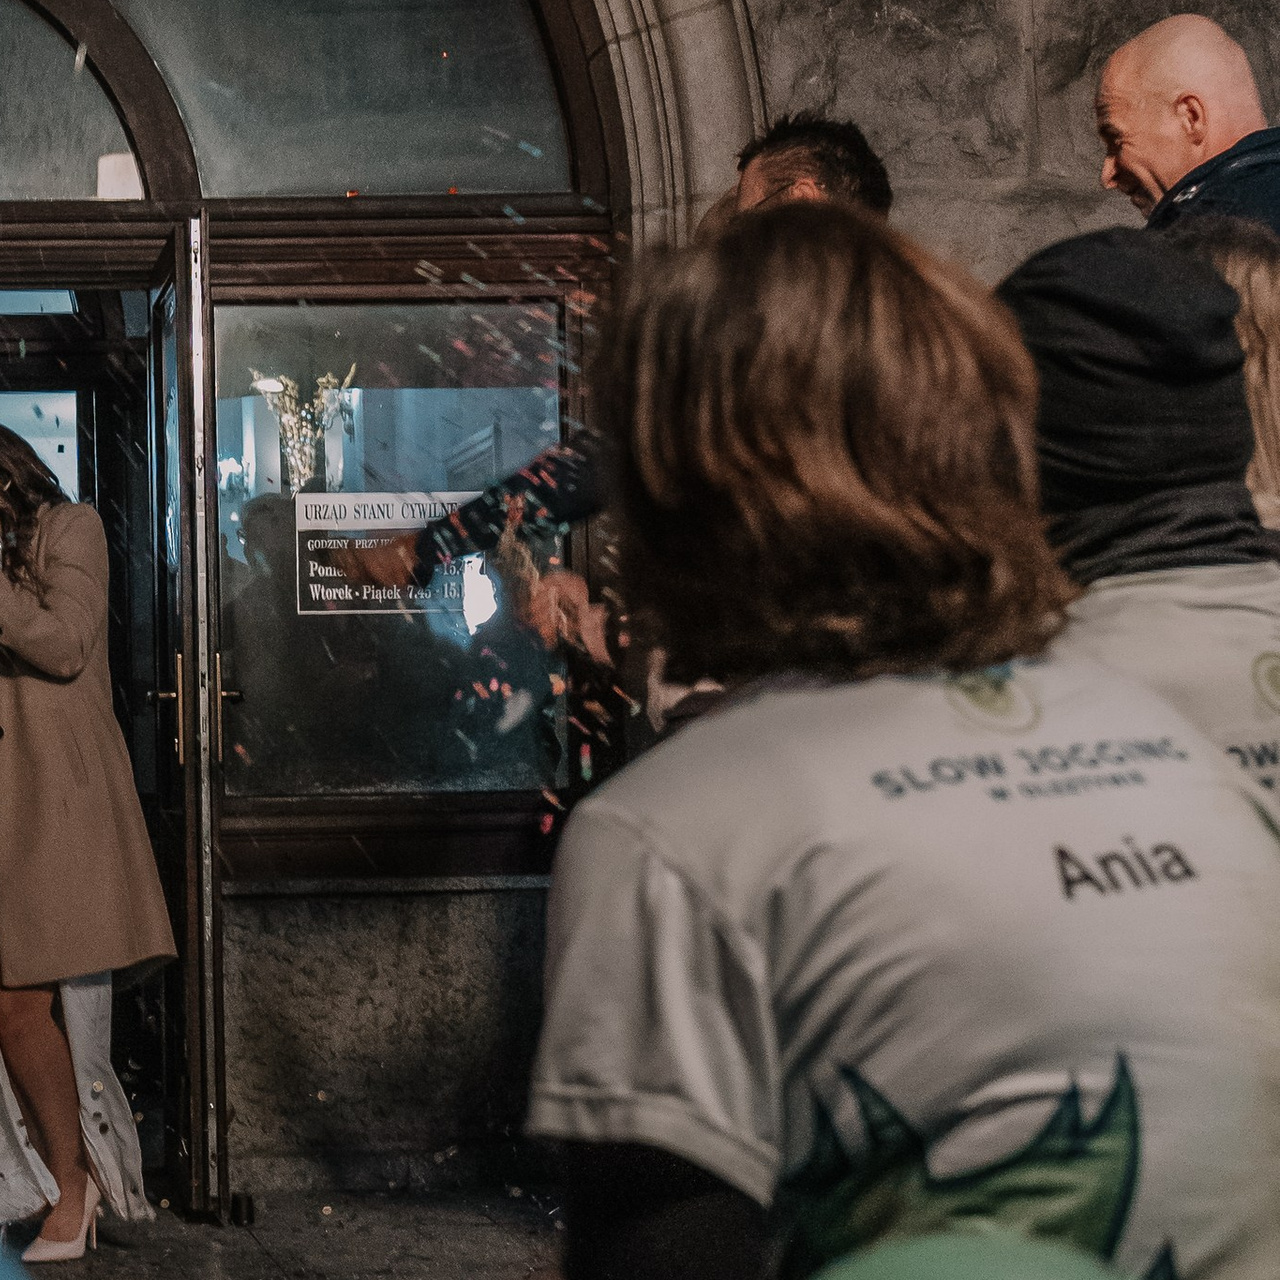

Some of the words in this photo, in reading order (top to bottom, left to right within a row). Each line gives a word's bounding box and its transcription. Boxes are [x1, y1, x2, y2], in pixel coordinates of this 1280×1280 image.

[304, 503, 347, 522] URZĄD
[354, 503, 394, 519] STANU
[401, 502, 459, 519] CYWILNE
[308, 539, 349, 551] GODZINY
[308, 561, 347, 577] Ponie
[309, 584, 352, 601] Wtorek
[362, 585, 401, 603] Piątek
[870, 752, 1007, 801] SLOW
[1053, 834, 1198, 903] Ania
